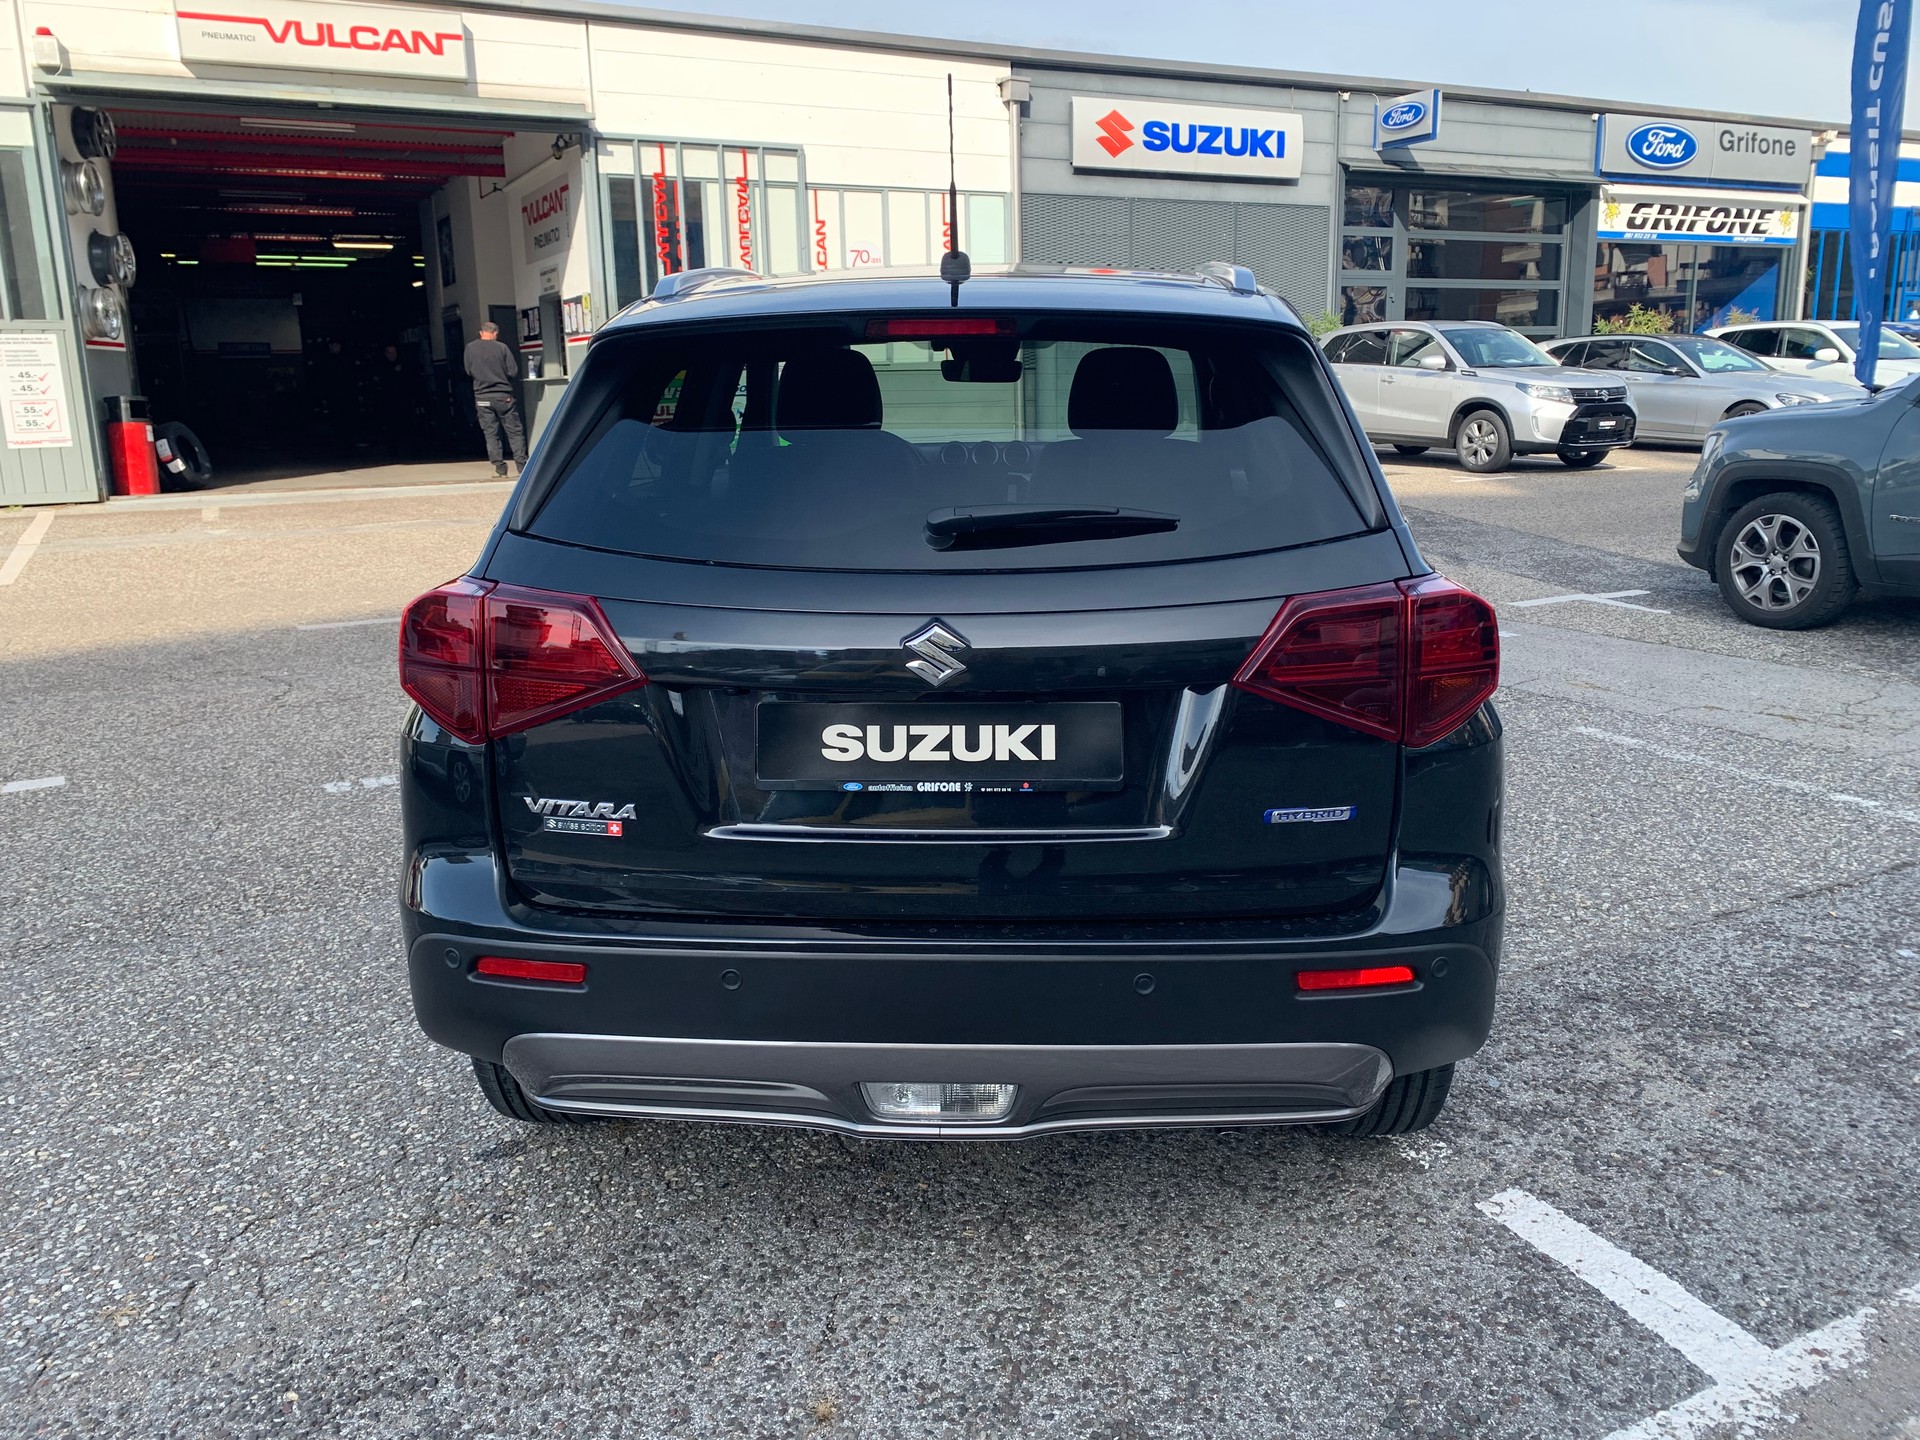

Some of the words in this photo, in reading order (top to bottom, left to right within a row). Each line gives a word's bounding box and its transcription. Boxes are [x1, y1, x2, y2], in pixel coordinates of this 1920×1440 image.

[201, 30, 256, 42] PNEUMATICI
[262, 18, 462, 56] VULCAN
[1387, 105, 1417, 126] Ford
[1142, 120, 1286, 159] SUZUKI
[1641, 128, 1688, 159] Ford
[1719, 129, 1796, 157] Grifone
[522, 184, 569, 226] VULCAN
[1626, 203, 1775, 235] GRIFONE
[534, 226, 560, 249] PNEUMATICI
[850, 249, 870, 267] 70
[821, 724, 1056, 762] SUZUKI
[916, 782, 961, 792] GRIFONE
[523, 796, 637, 820] VITARA
[1278, 809, 1345, 822] HYBRID
